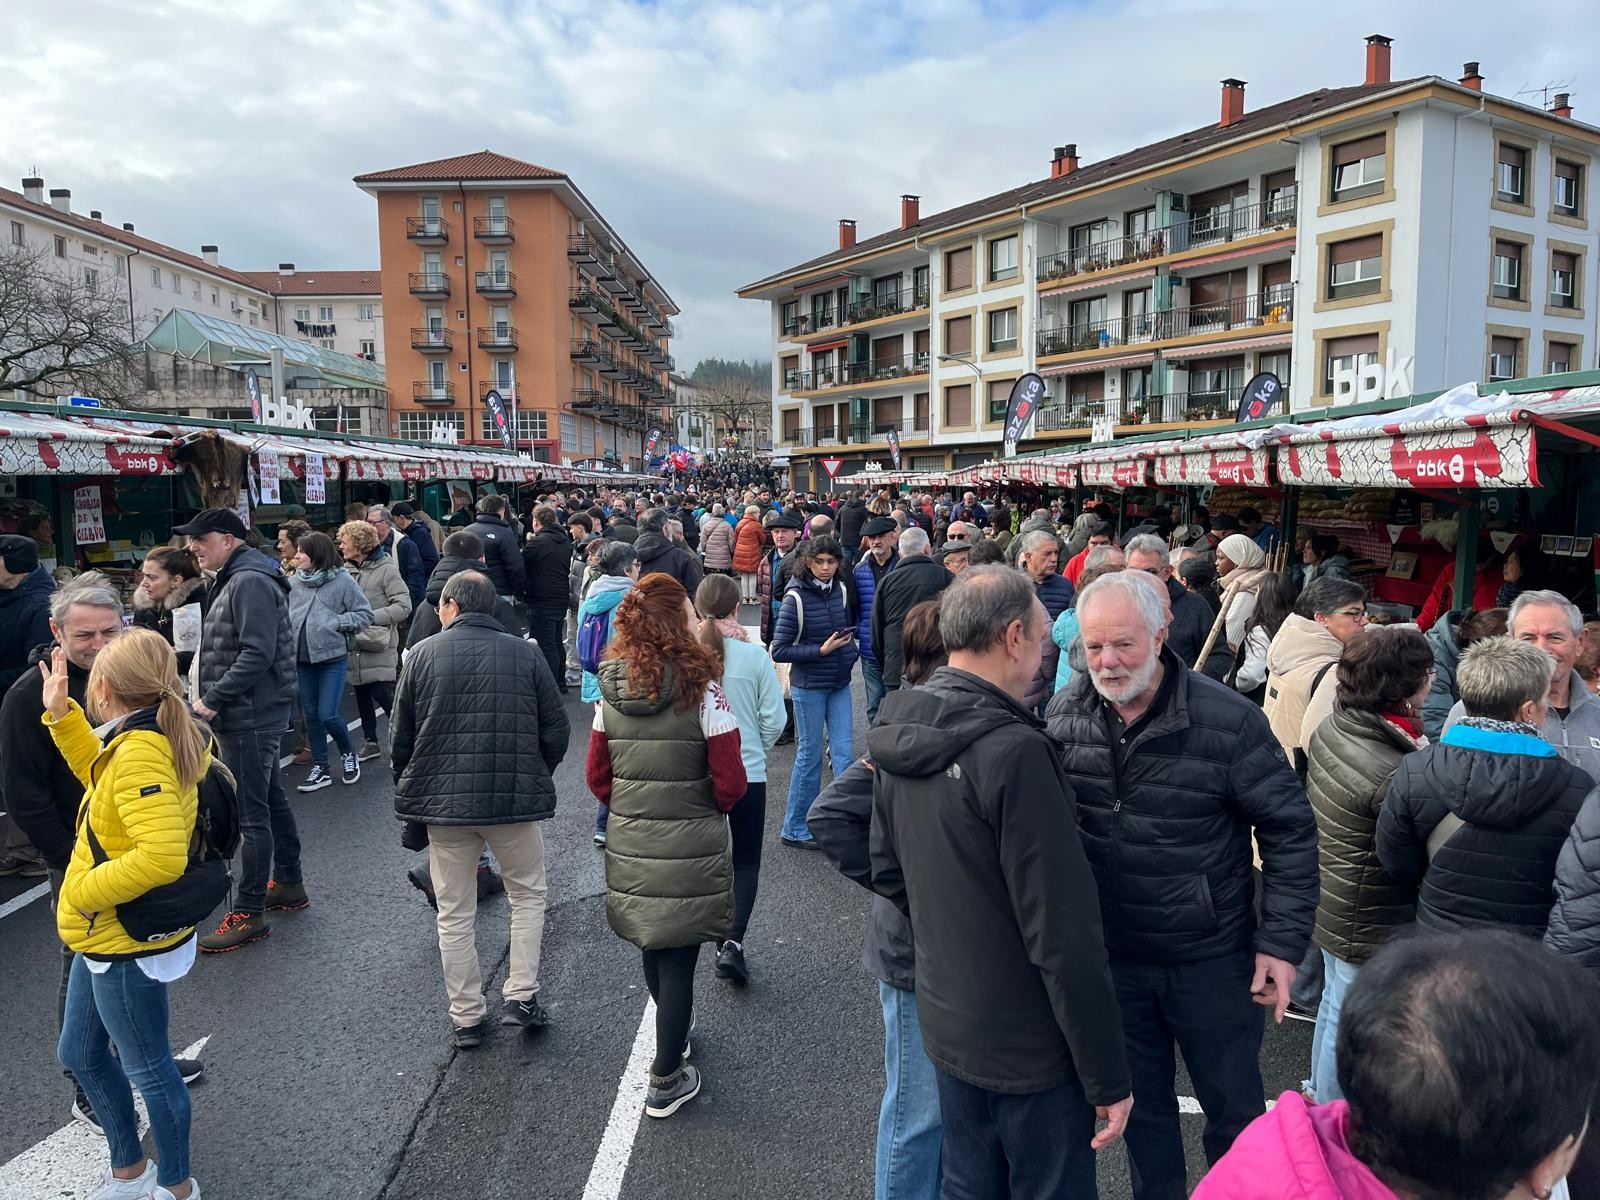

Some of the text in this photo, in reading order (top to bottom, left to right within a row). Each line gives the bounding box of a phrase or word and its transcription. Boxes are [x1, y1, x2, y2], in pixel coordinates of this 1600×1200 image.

[1333, 348, 1415, 406] bbk
[261, 393, 316, 431] bbk
[127, 458, 148, 469] bbk
[865, 461, 882, 471] bbk
[1416, 459, 1448, 477] bbk
[78, 514, 87, 523] DE
[77, 527, 104, 541] CIERVO
